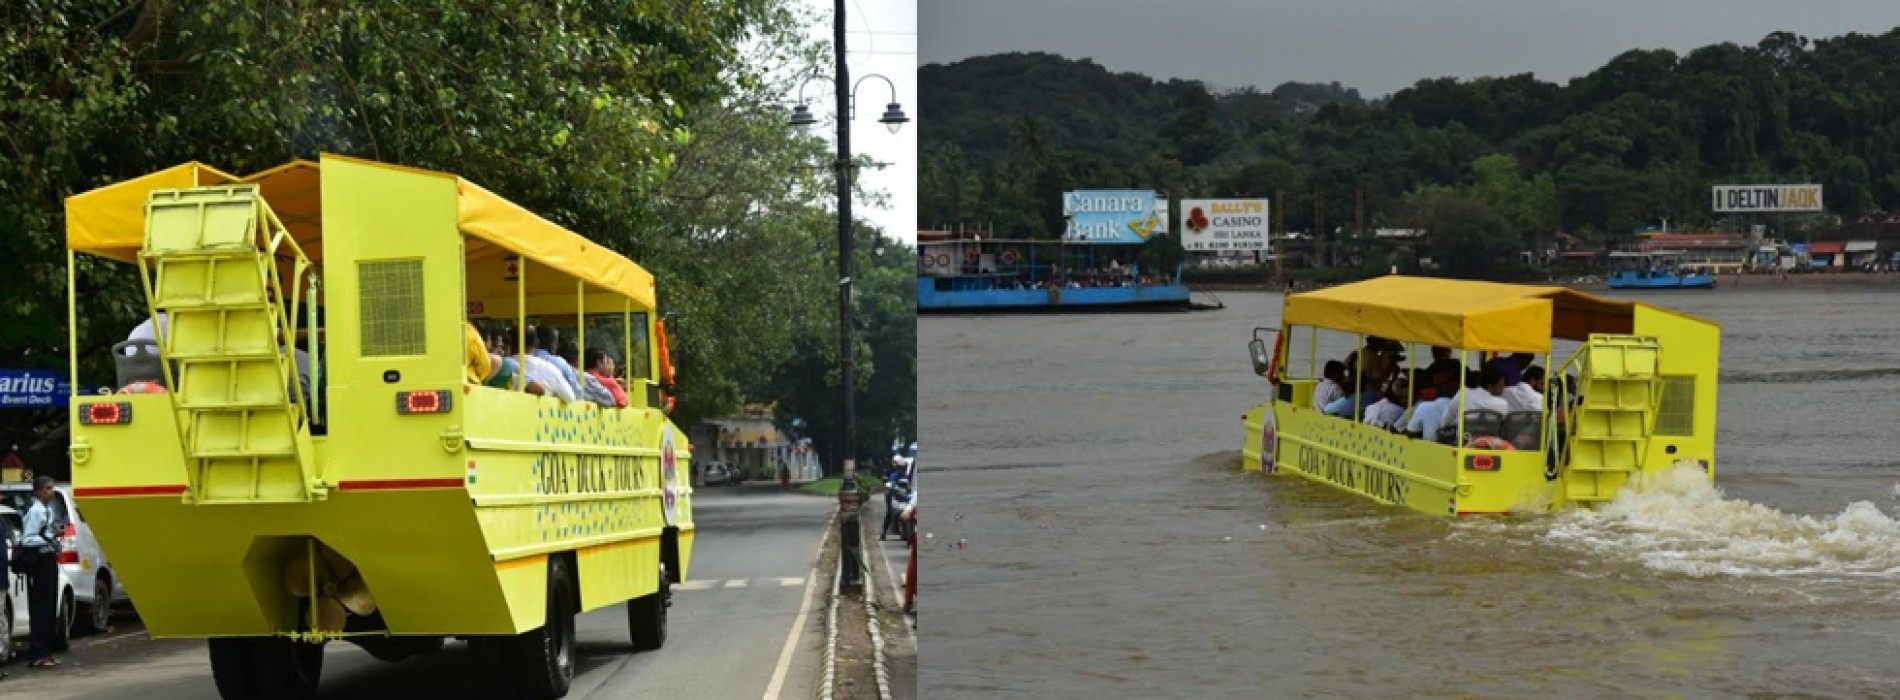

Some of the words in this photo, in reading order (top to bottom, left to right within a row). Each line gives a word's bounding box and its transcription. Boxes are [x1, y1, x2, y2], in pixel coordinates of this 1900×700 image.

[1066, 193, 1143, 212] Canara
[1066, 220, 1120, 239] Bank
[1212, 216, 1262, 227] CASINO
[540, 451, 568, 495] GOA
[576, 453, 607, 493] DUCK
[613, 455, 645, 491] TOURS
[1299, 445, 1319, 476] GOA
[1326, 453, 1354, 489] DUCK
[1364, 464, 1403, 504] TOURS
